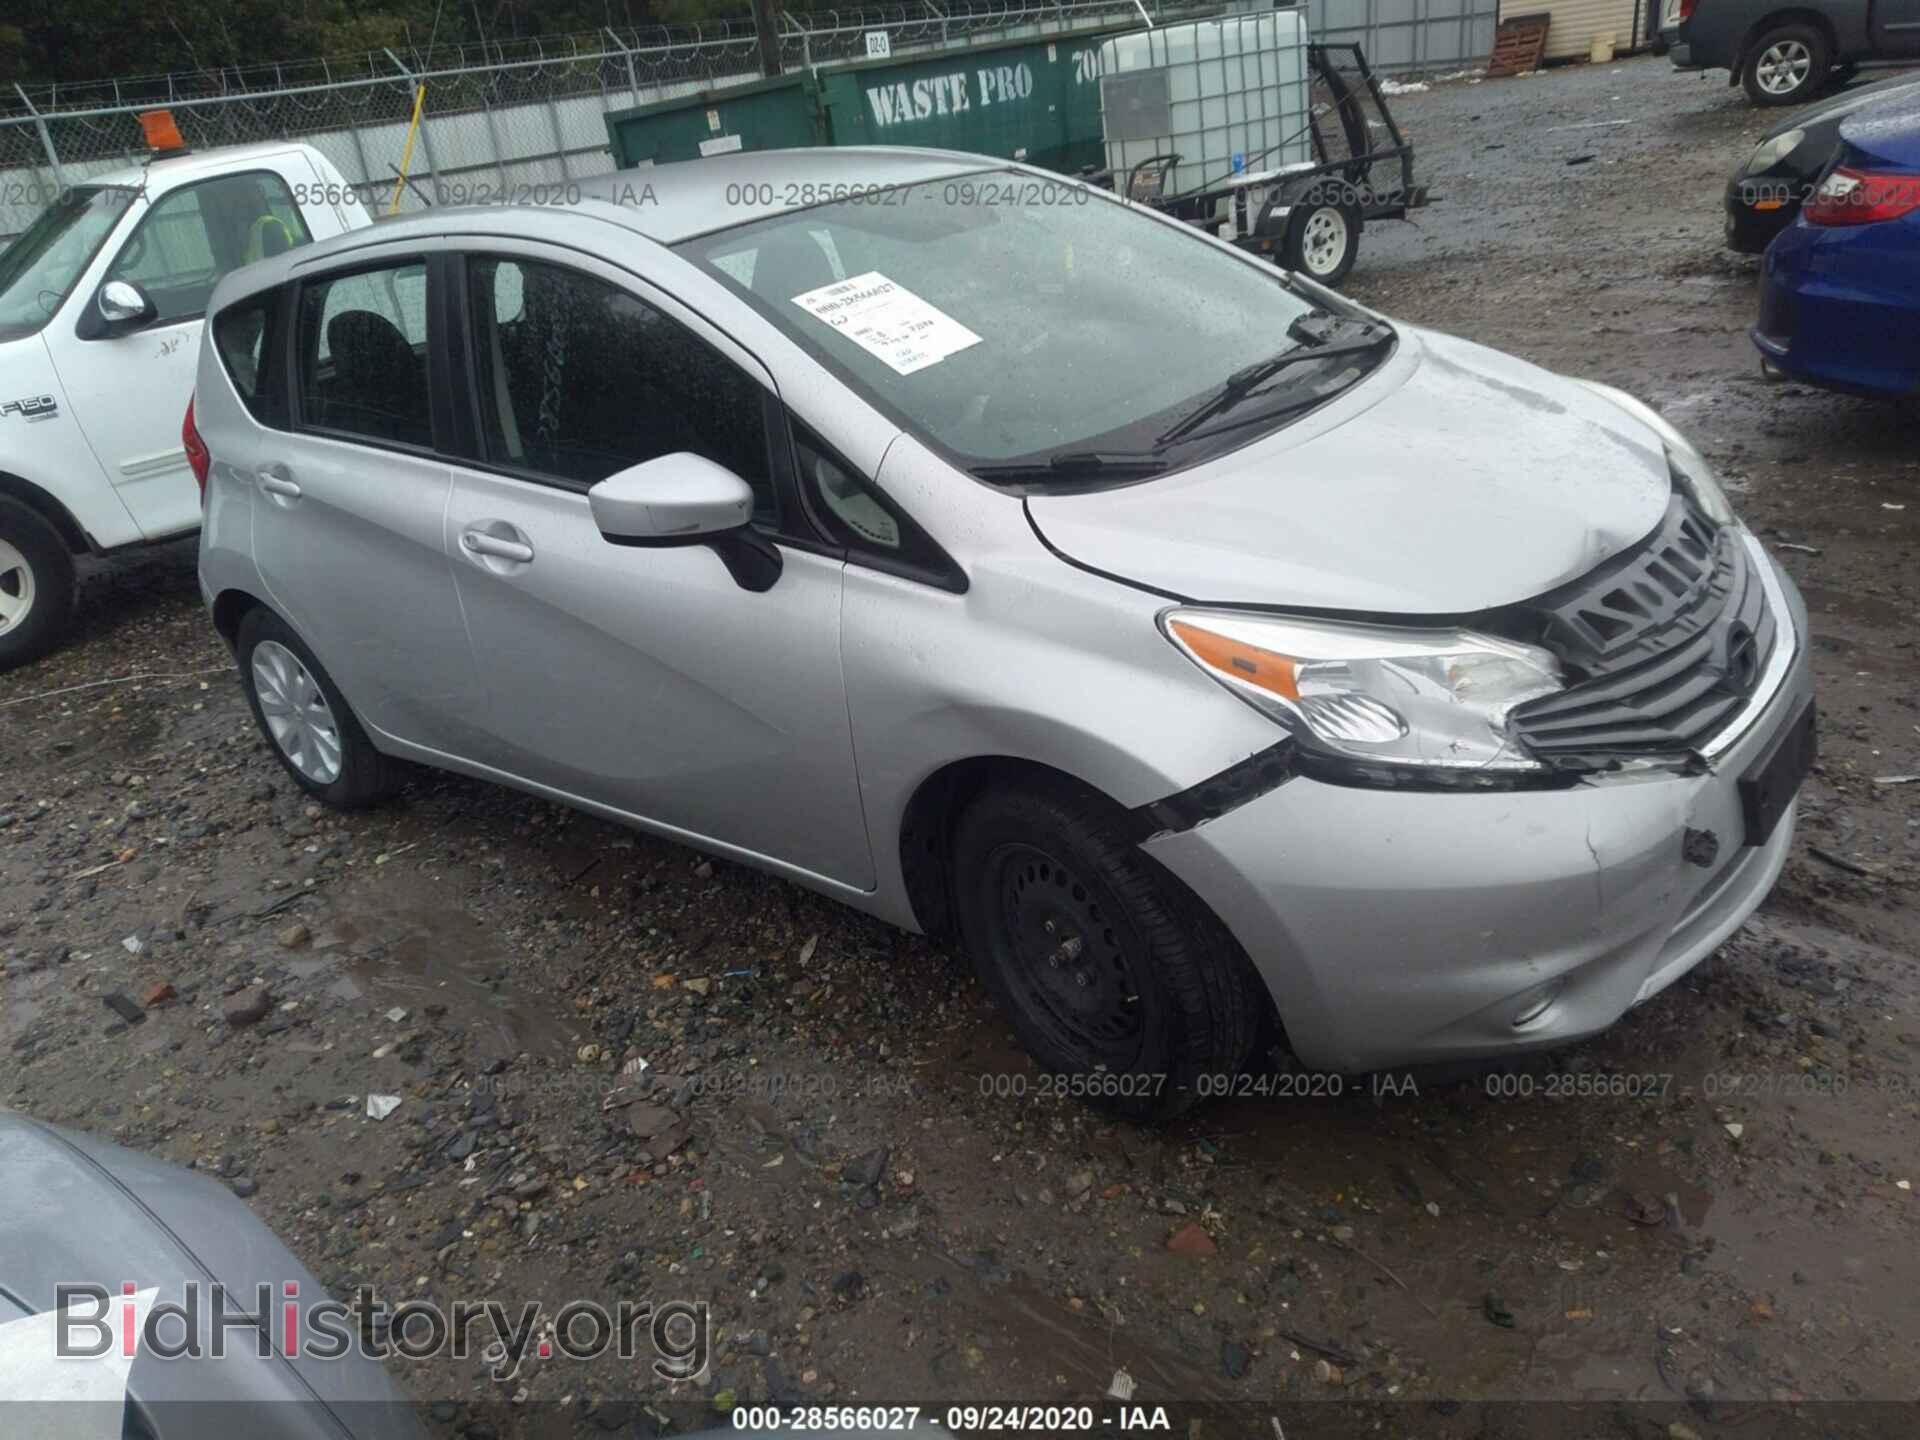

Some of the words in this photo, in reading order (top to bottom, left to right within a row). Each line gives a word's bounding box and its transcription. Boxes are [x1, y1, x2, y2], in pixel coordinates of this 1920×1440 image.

[866, 73, 970, 127] WASTE
[977, 63, 1033, 106] PRO
[0, 394, 56, 416] F150
